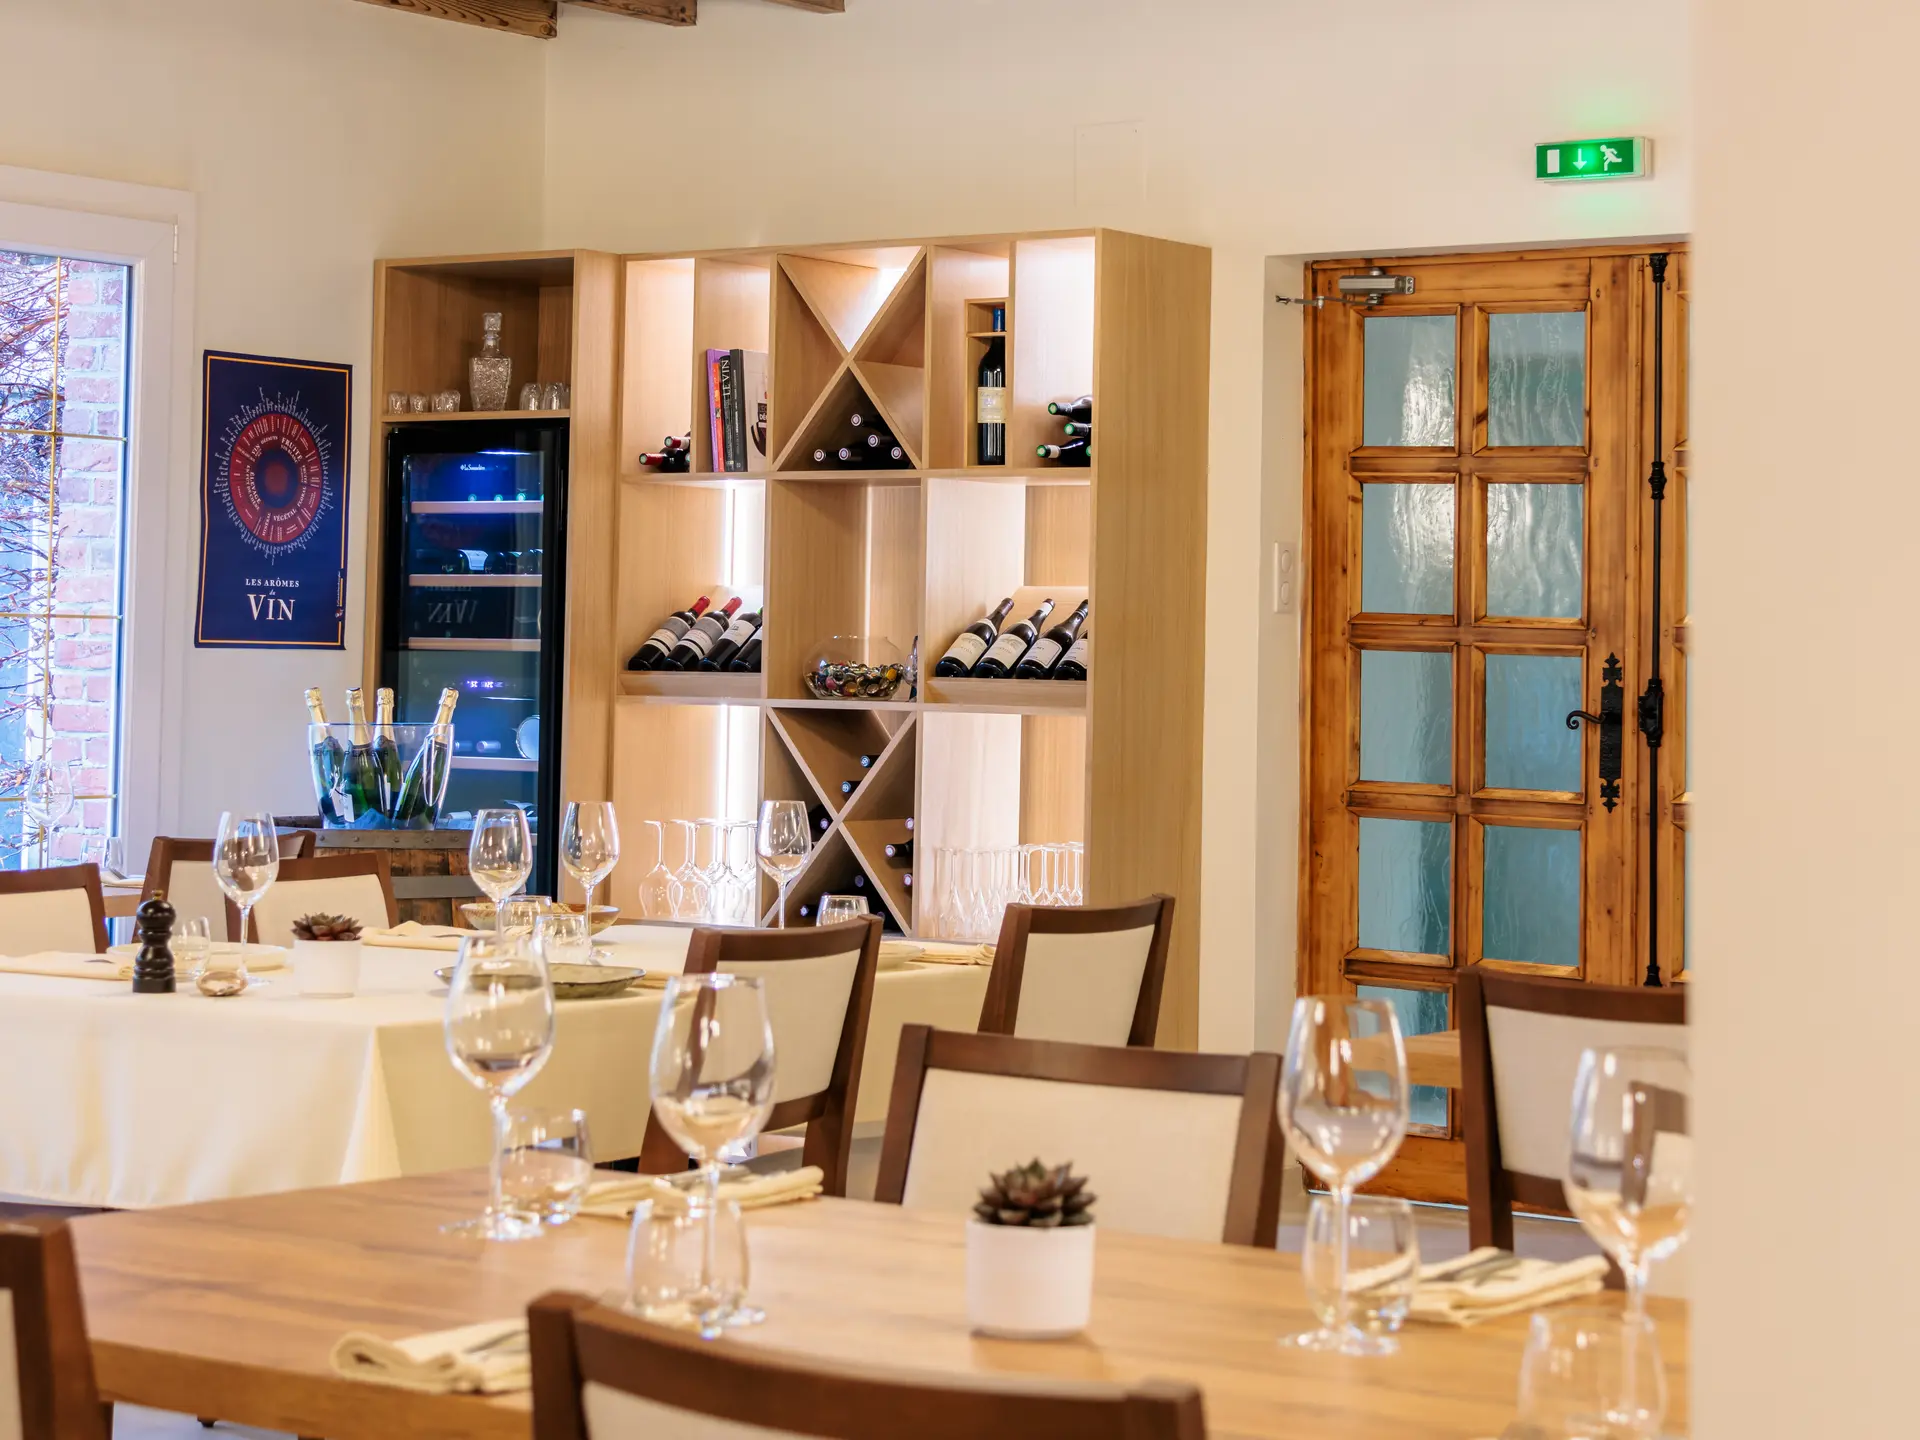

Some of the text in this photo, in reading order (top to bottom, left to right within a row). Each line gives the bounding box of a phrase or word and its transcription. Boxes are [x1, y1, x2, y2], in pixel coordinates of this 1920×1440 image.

[245, 577, 300, 588] LES ARÔMES
[247, 593, 295, 621] VIN
